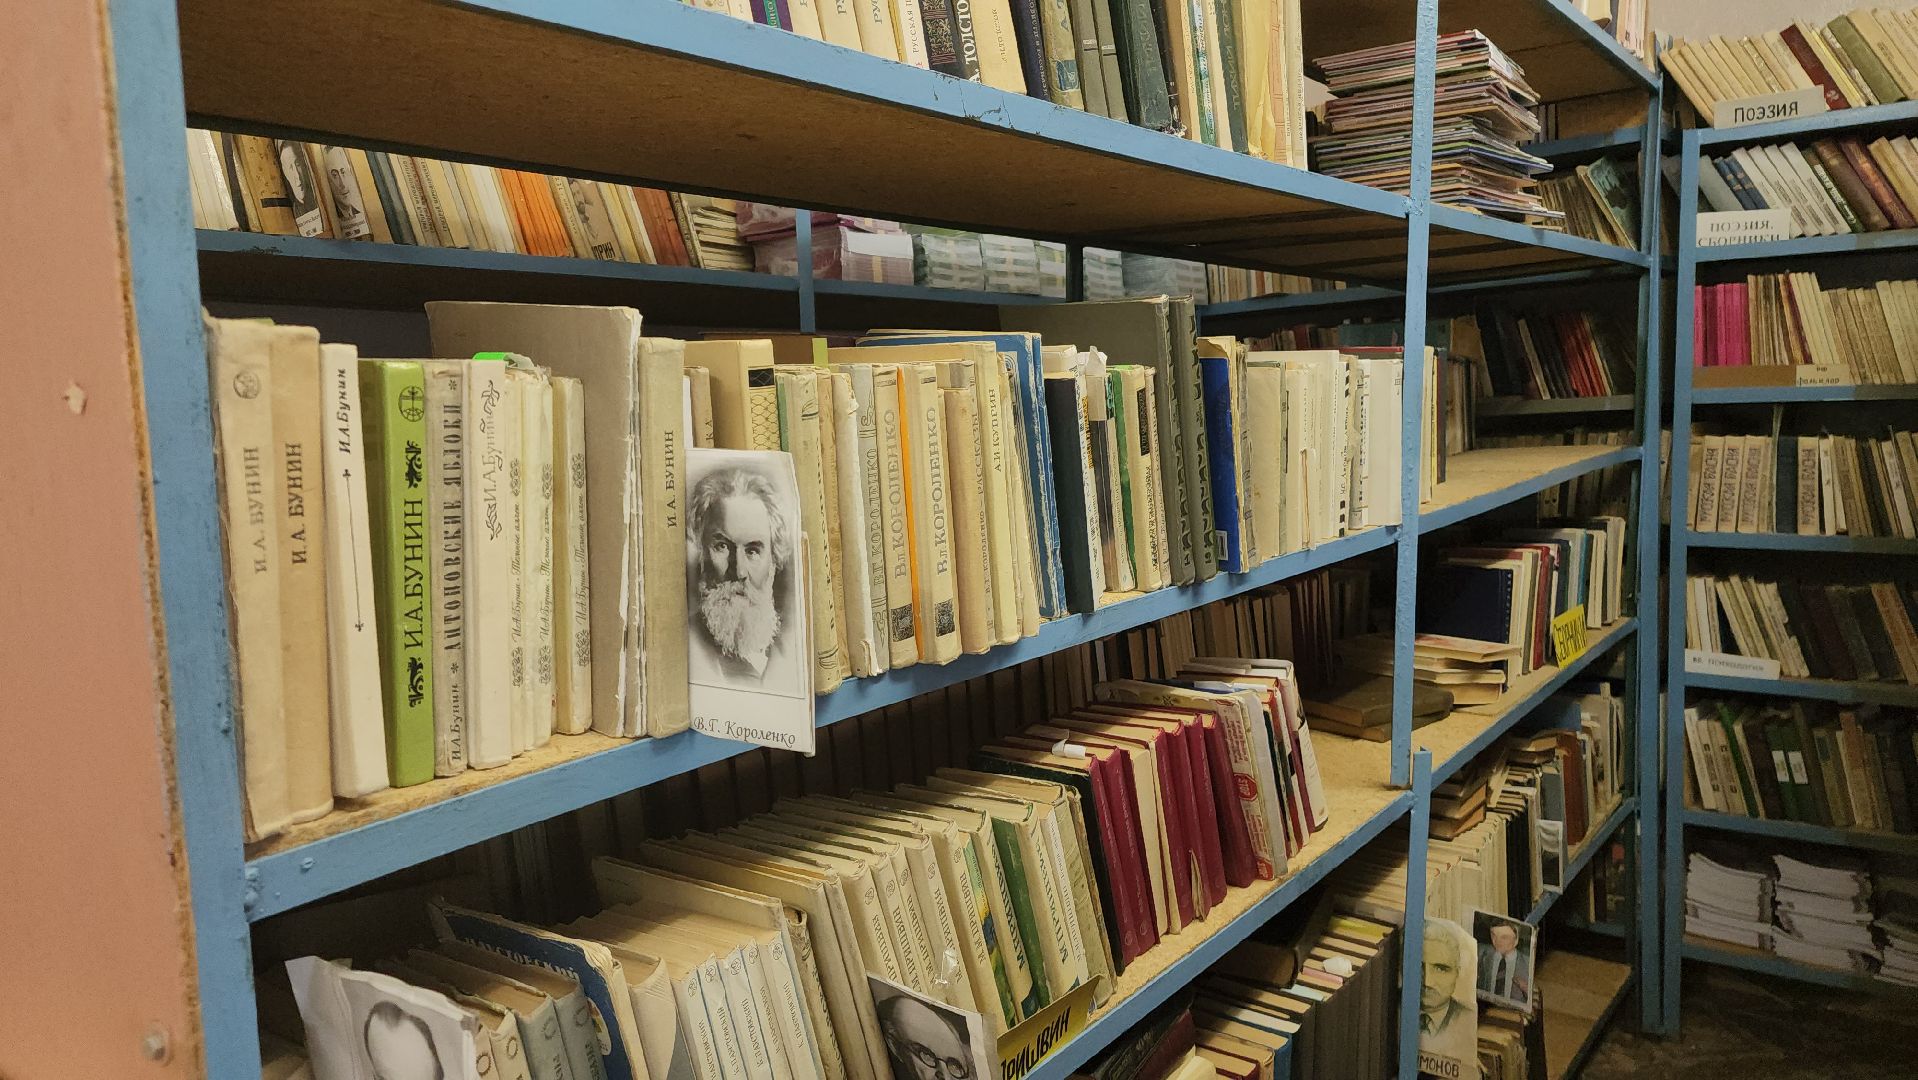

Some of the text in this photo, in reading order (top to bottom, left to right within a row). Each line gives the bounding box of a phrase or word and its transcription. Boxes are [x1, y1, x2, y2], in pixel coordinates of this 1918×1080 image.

[906, 10, 920, 54] РУССКАЯ
[1028, 0, 1040, 38] ОВЕСТИ
[1734, 101, 1798, 124] ПОЭЗИЯ
[442, 403, 462, 487] ЯБЛОКИ
[664, 431, 675, 491] БУНИН
[243, 447, 264, 526] БУНИН
[285, 443, 305, 518] БУНИН
[724, 720, 796, 748] Короленко
[1417, 1055, 1459, 1077] МОНОВ
